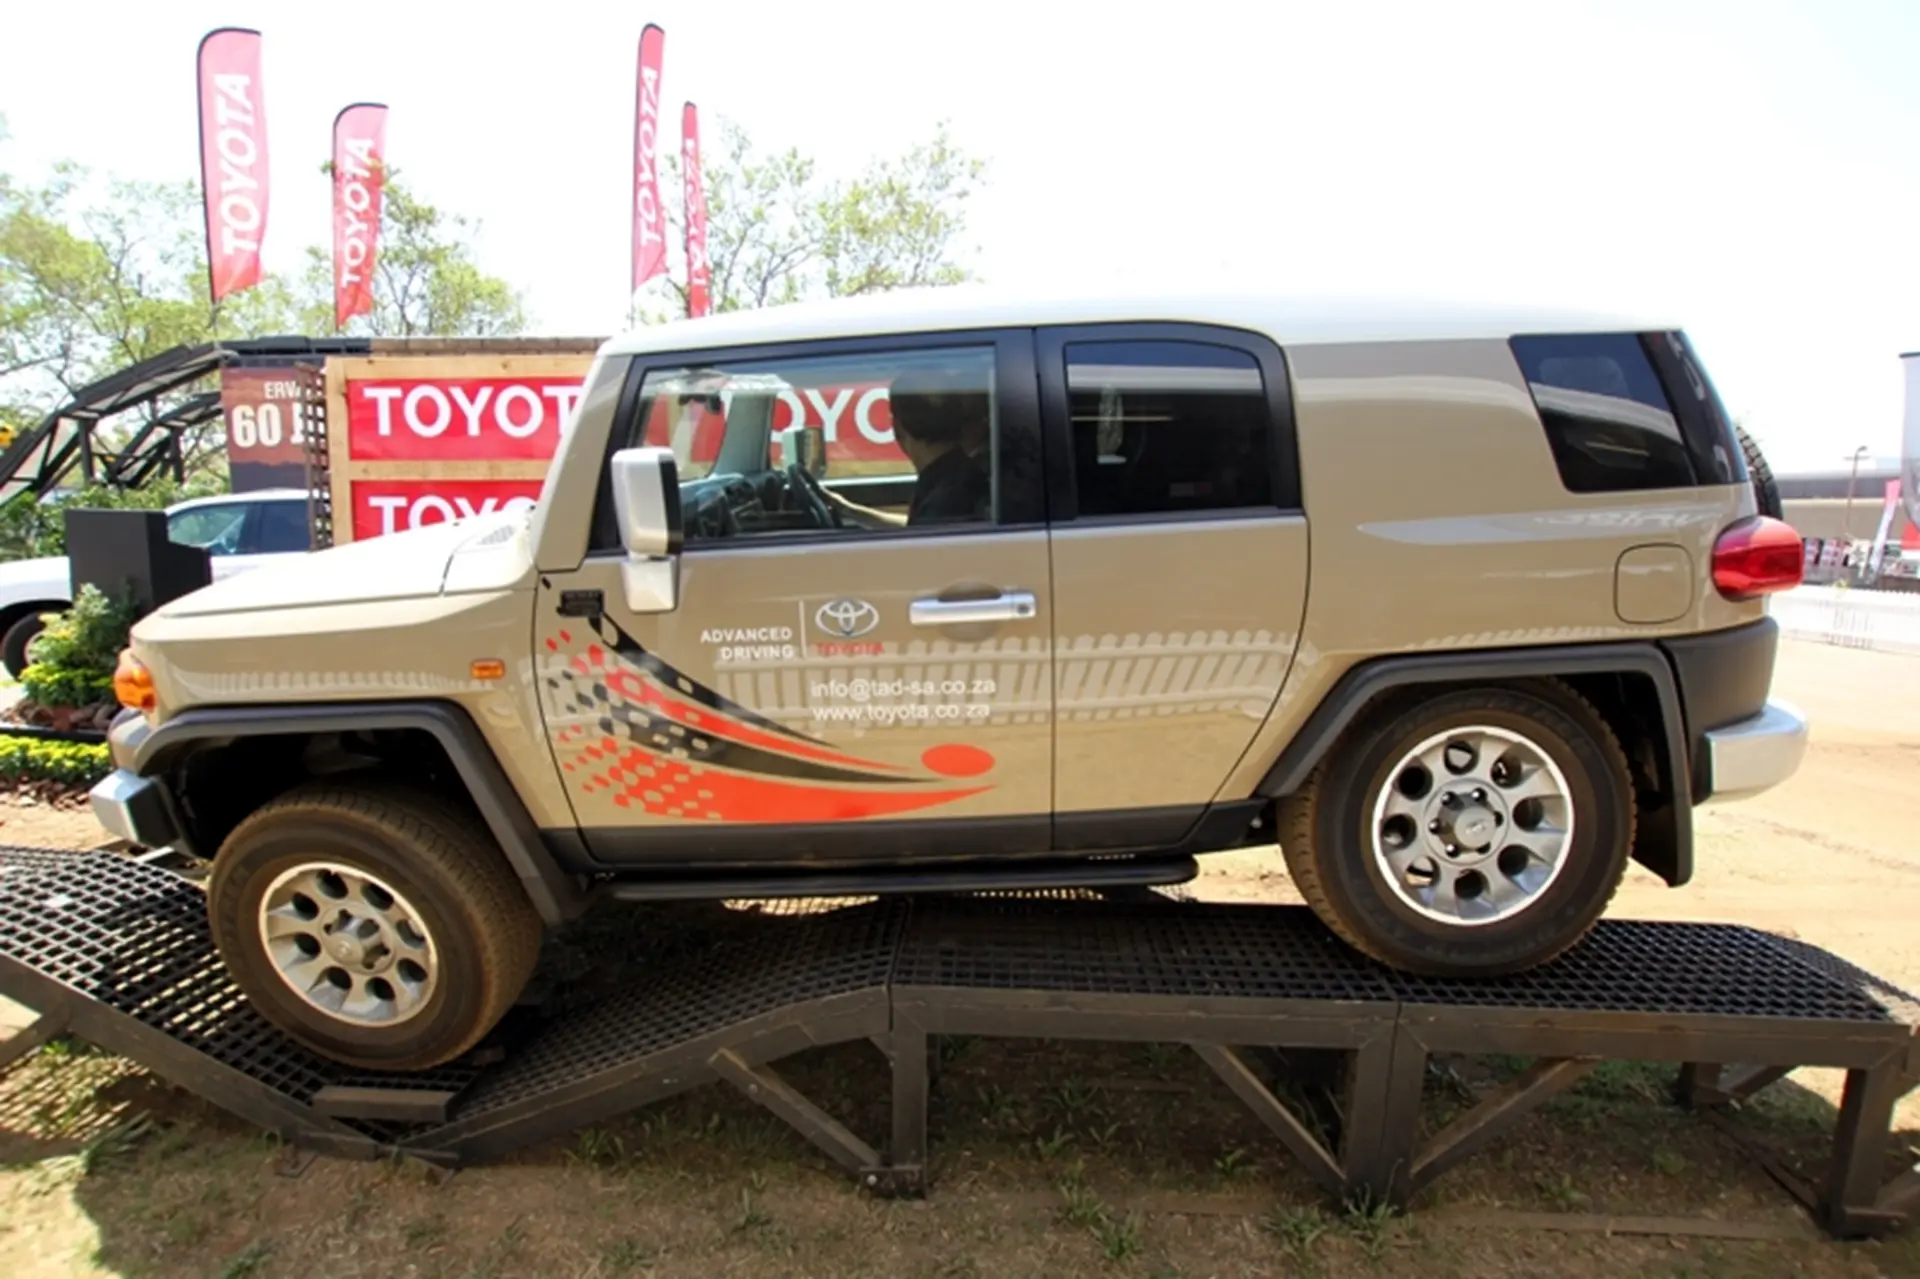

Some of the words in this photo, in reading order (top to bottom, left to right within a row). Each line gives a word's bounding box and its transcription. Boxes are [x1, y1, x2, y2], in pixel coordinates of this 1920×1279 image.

[214, 74, 258, 255] TOYOTA
[637, 65, 661, 246] TOYOTA
[341, 138, 375, 288] TOYOTA
[232, 404, 282, 447] 60
[363, 385, 584, 438] TOYOT
[701, 627, 792, 643] ADVANCED
[721, 644, 795, 660] DRIVING
[811, 679, 996, 702] info@tad-sa.co.za
[812, 703, 991, 723] www.toyota.co.za
